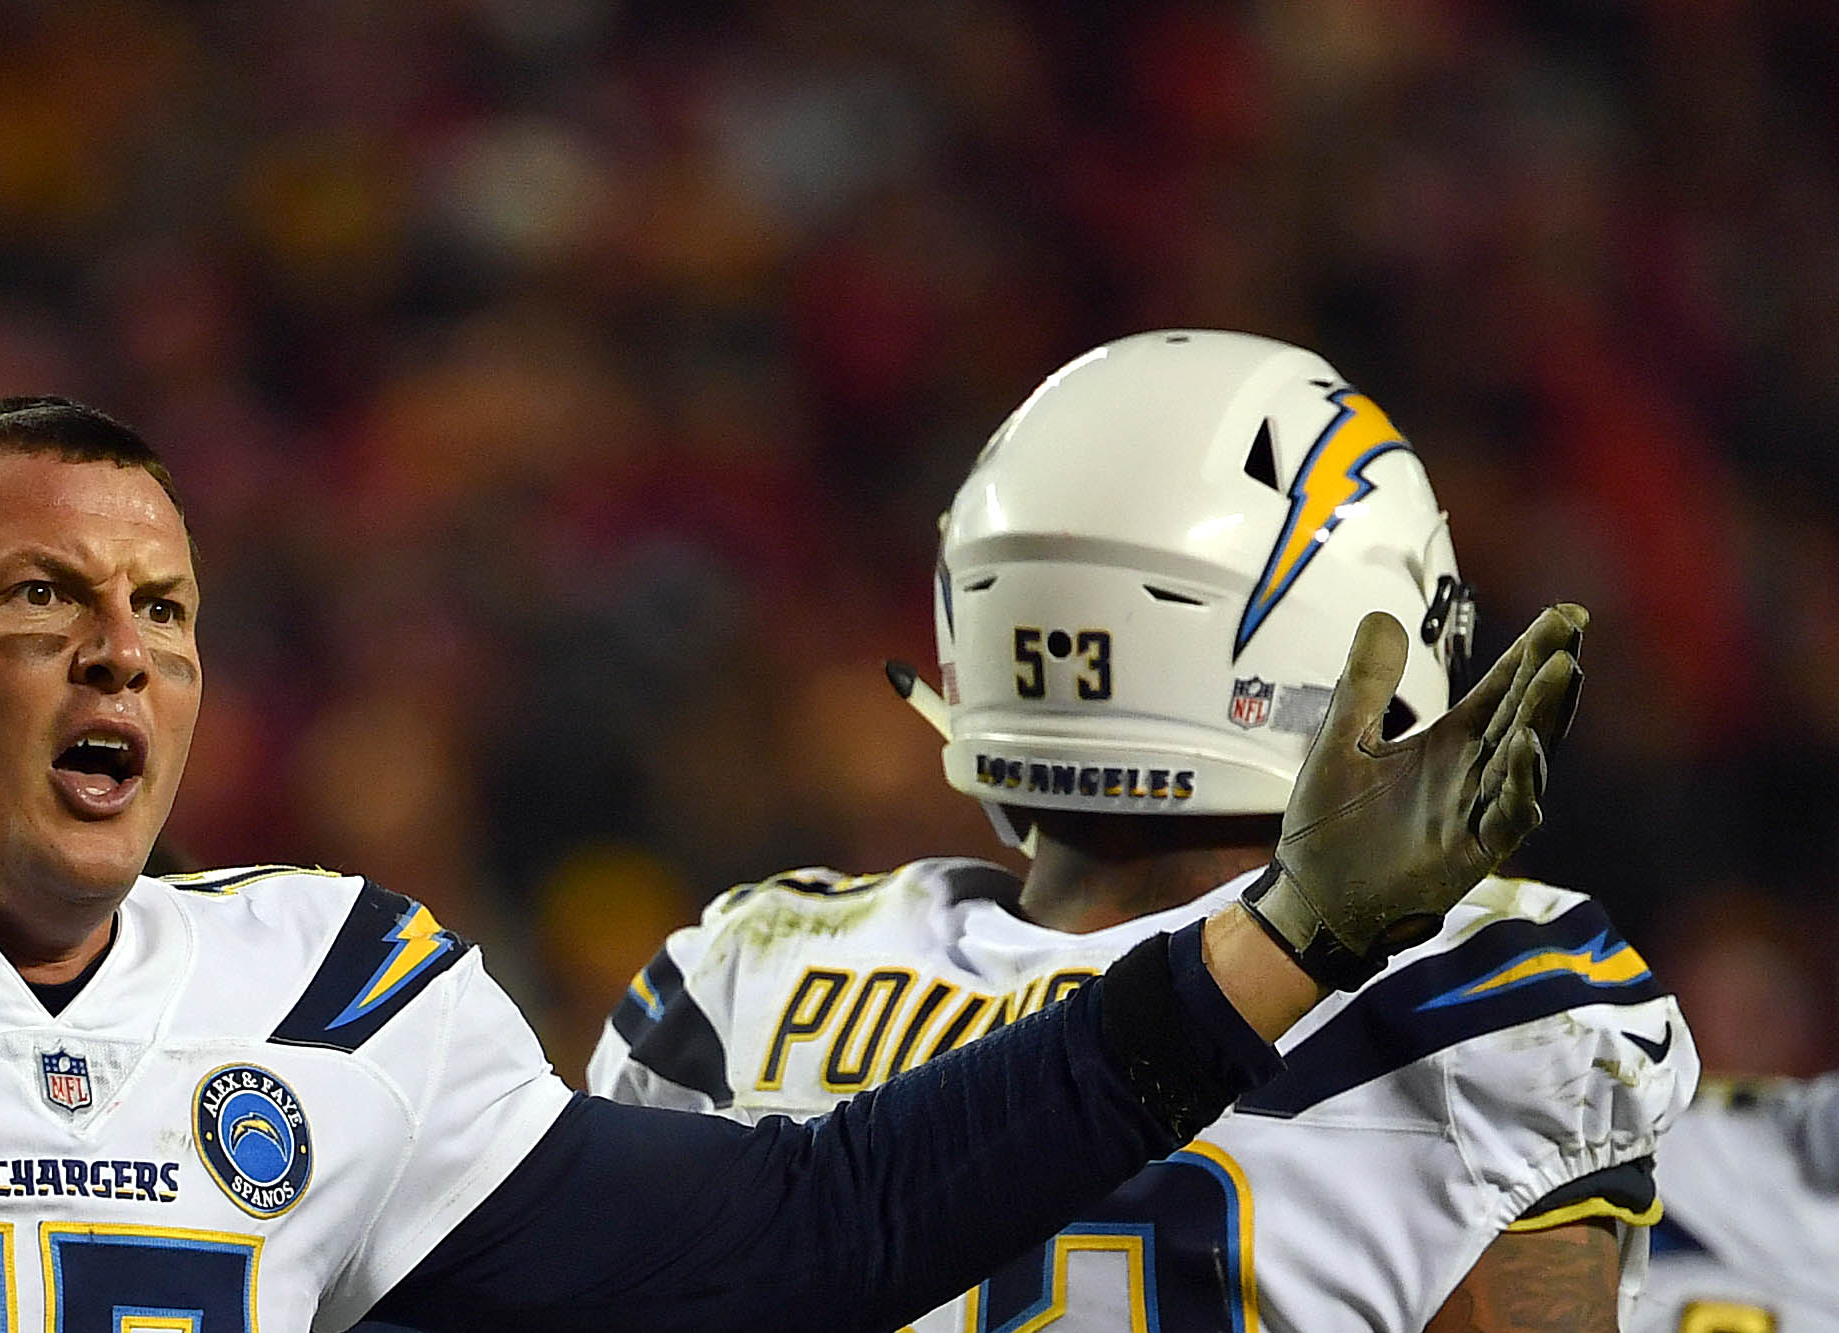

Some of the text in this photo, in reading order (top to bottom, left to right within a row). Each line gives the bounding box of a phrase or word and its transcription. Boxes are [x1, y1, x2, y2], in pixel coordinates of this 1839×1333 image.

[976, 754, 1196, 799] LOS ANGELES
[202, 1071, 303, 1128] ALEX & FAYE
[231, 1175, 295, 1209] SPANOS
